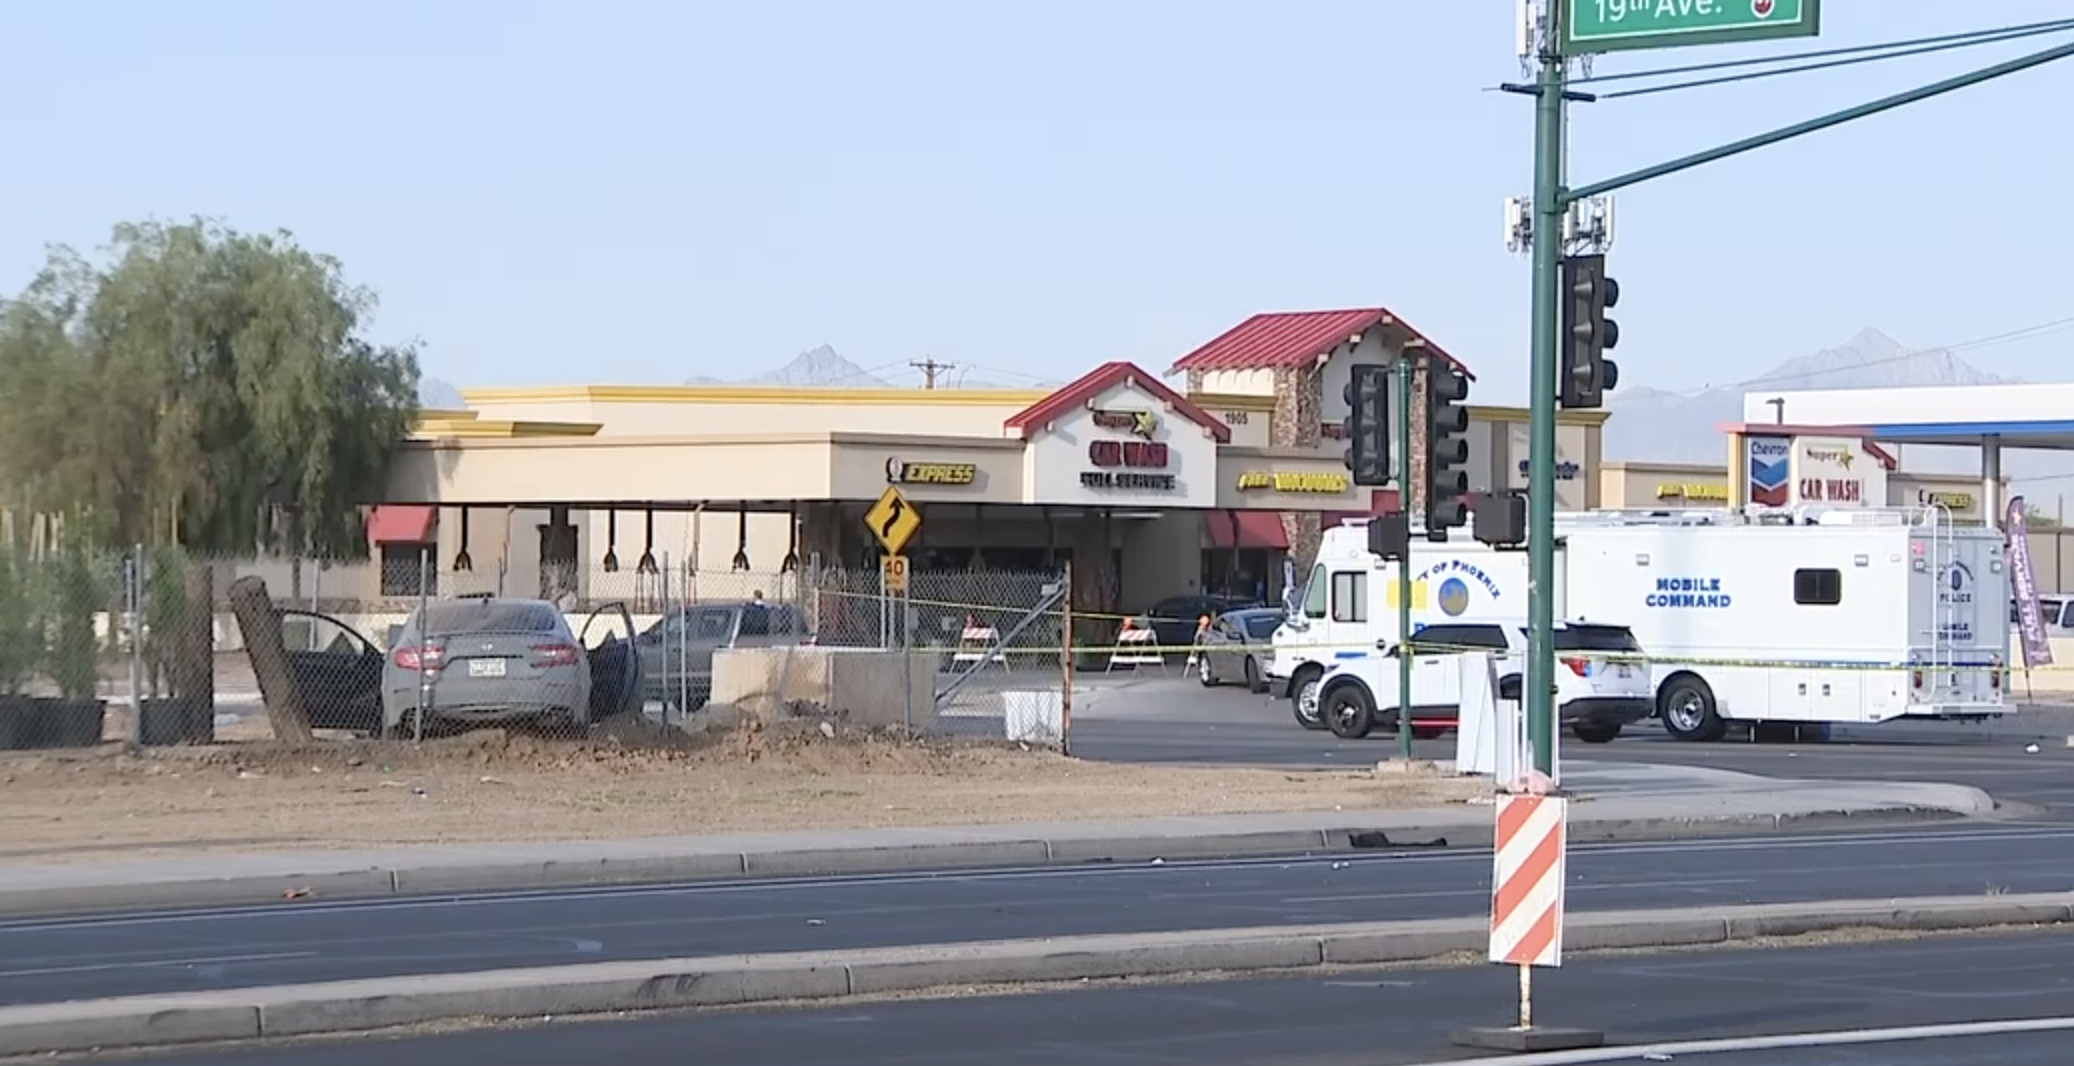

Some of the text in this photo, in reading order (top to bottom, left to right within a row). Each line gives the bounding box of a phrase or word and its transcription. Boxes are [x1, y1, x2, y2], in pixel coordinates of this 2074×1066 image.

[1653, 0, 1723, 19] Ave.
[1225, 412, 1248, 425] 1905
[1090, 440, 1168, 467] CAR WASH
[1752, 442, 1788, 455] Chevron
[1807, 448, 1837, 463] Super
[906, 464, 974, 483] EXPRESS
[1800, 478, 1859, 502] CAR WASH
[1432, 561, 1447, 574] OF
[1452, 560, 1500, 600] PHOENIX
[1656, 578, 1720, 591] MOBILE
[1645, 594, 1731, 608] COMMAND
